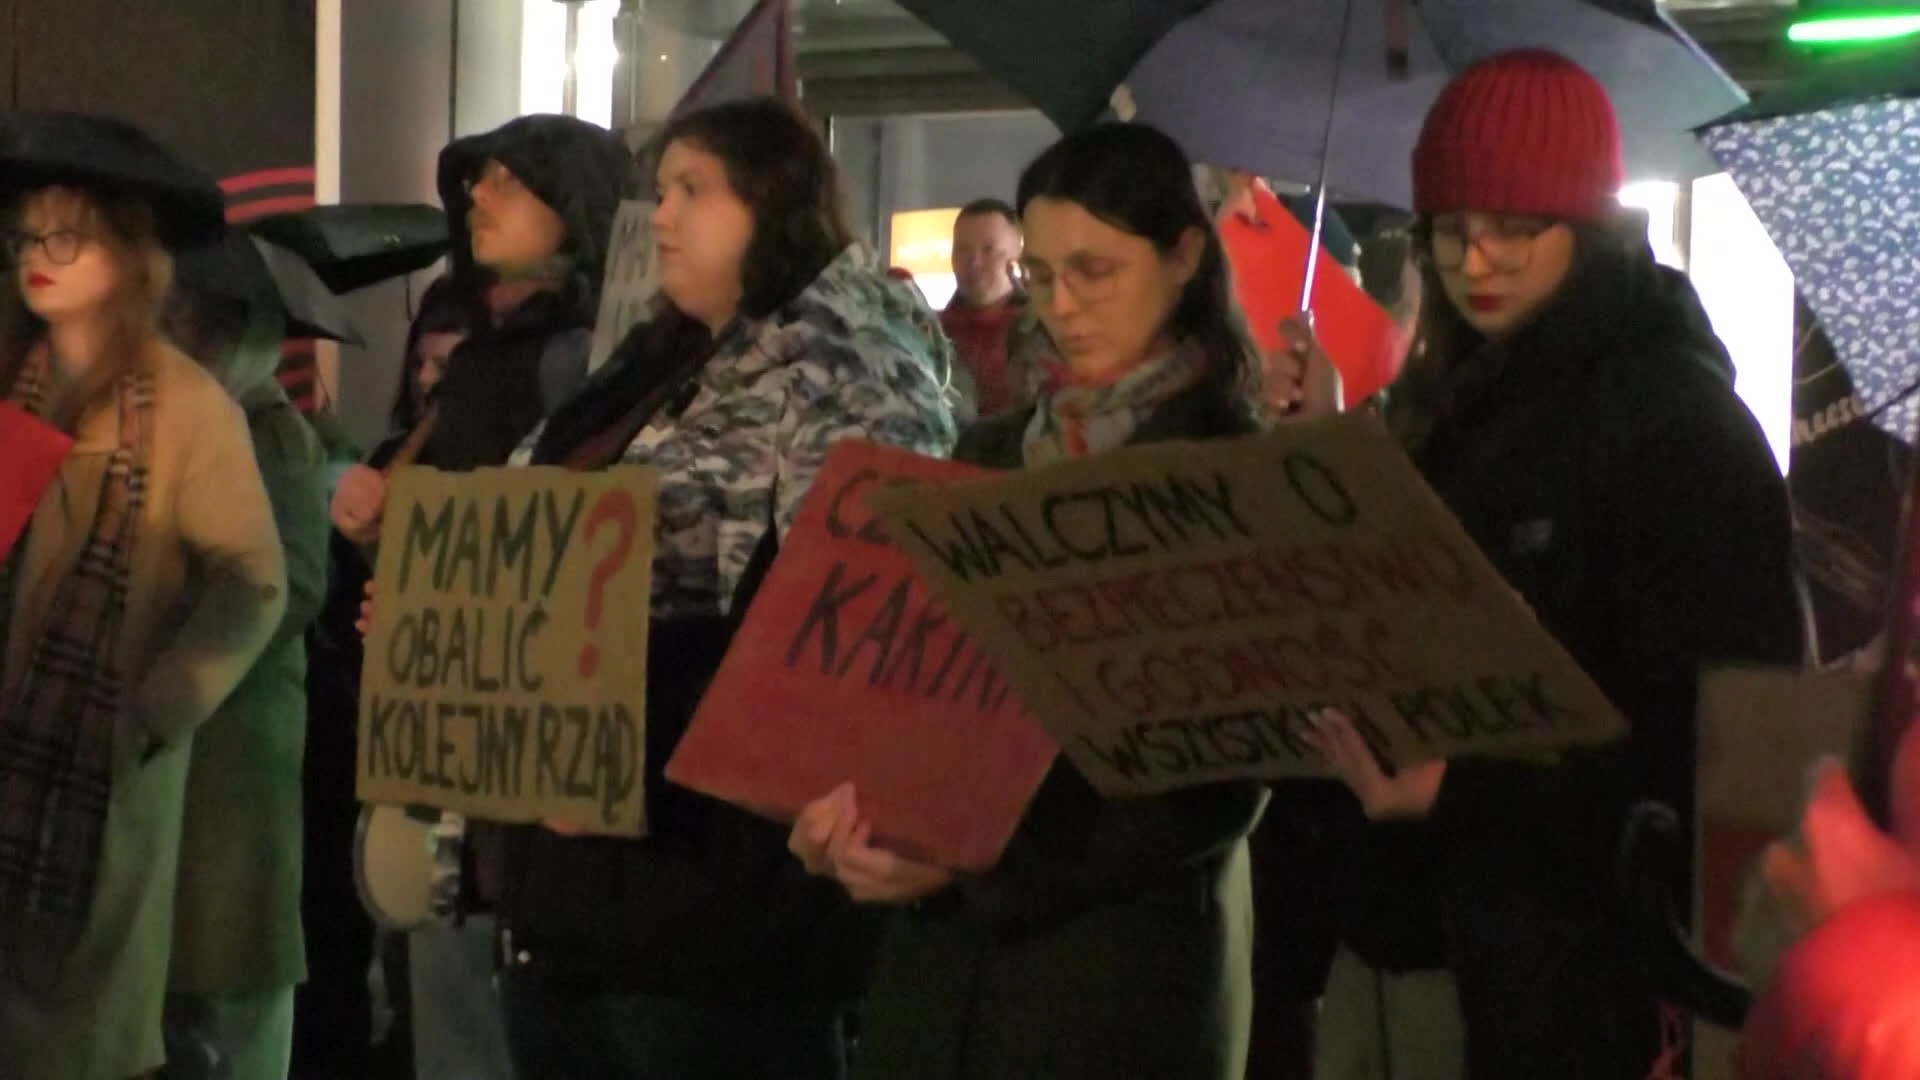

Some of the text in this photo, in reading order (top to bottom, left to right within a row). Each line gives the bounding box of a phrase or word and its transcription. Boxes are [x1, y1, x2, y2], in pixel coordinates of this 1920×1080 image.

[400, 487, 585, 601] MAMY
[904, 446, 1359, 584] WALCZYMY O
[388, 595, 550, 694] OBALIĆ
[368, 695, 639, 825] KOLEJNY RZĄD
